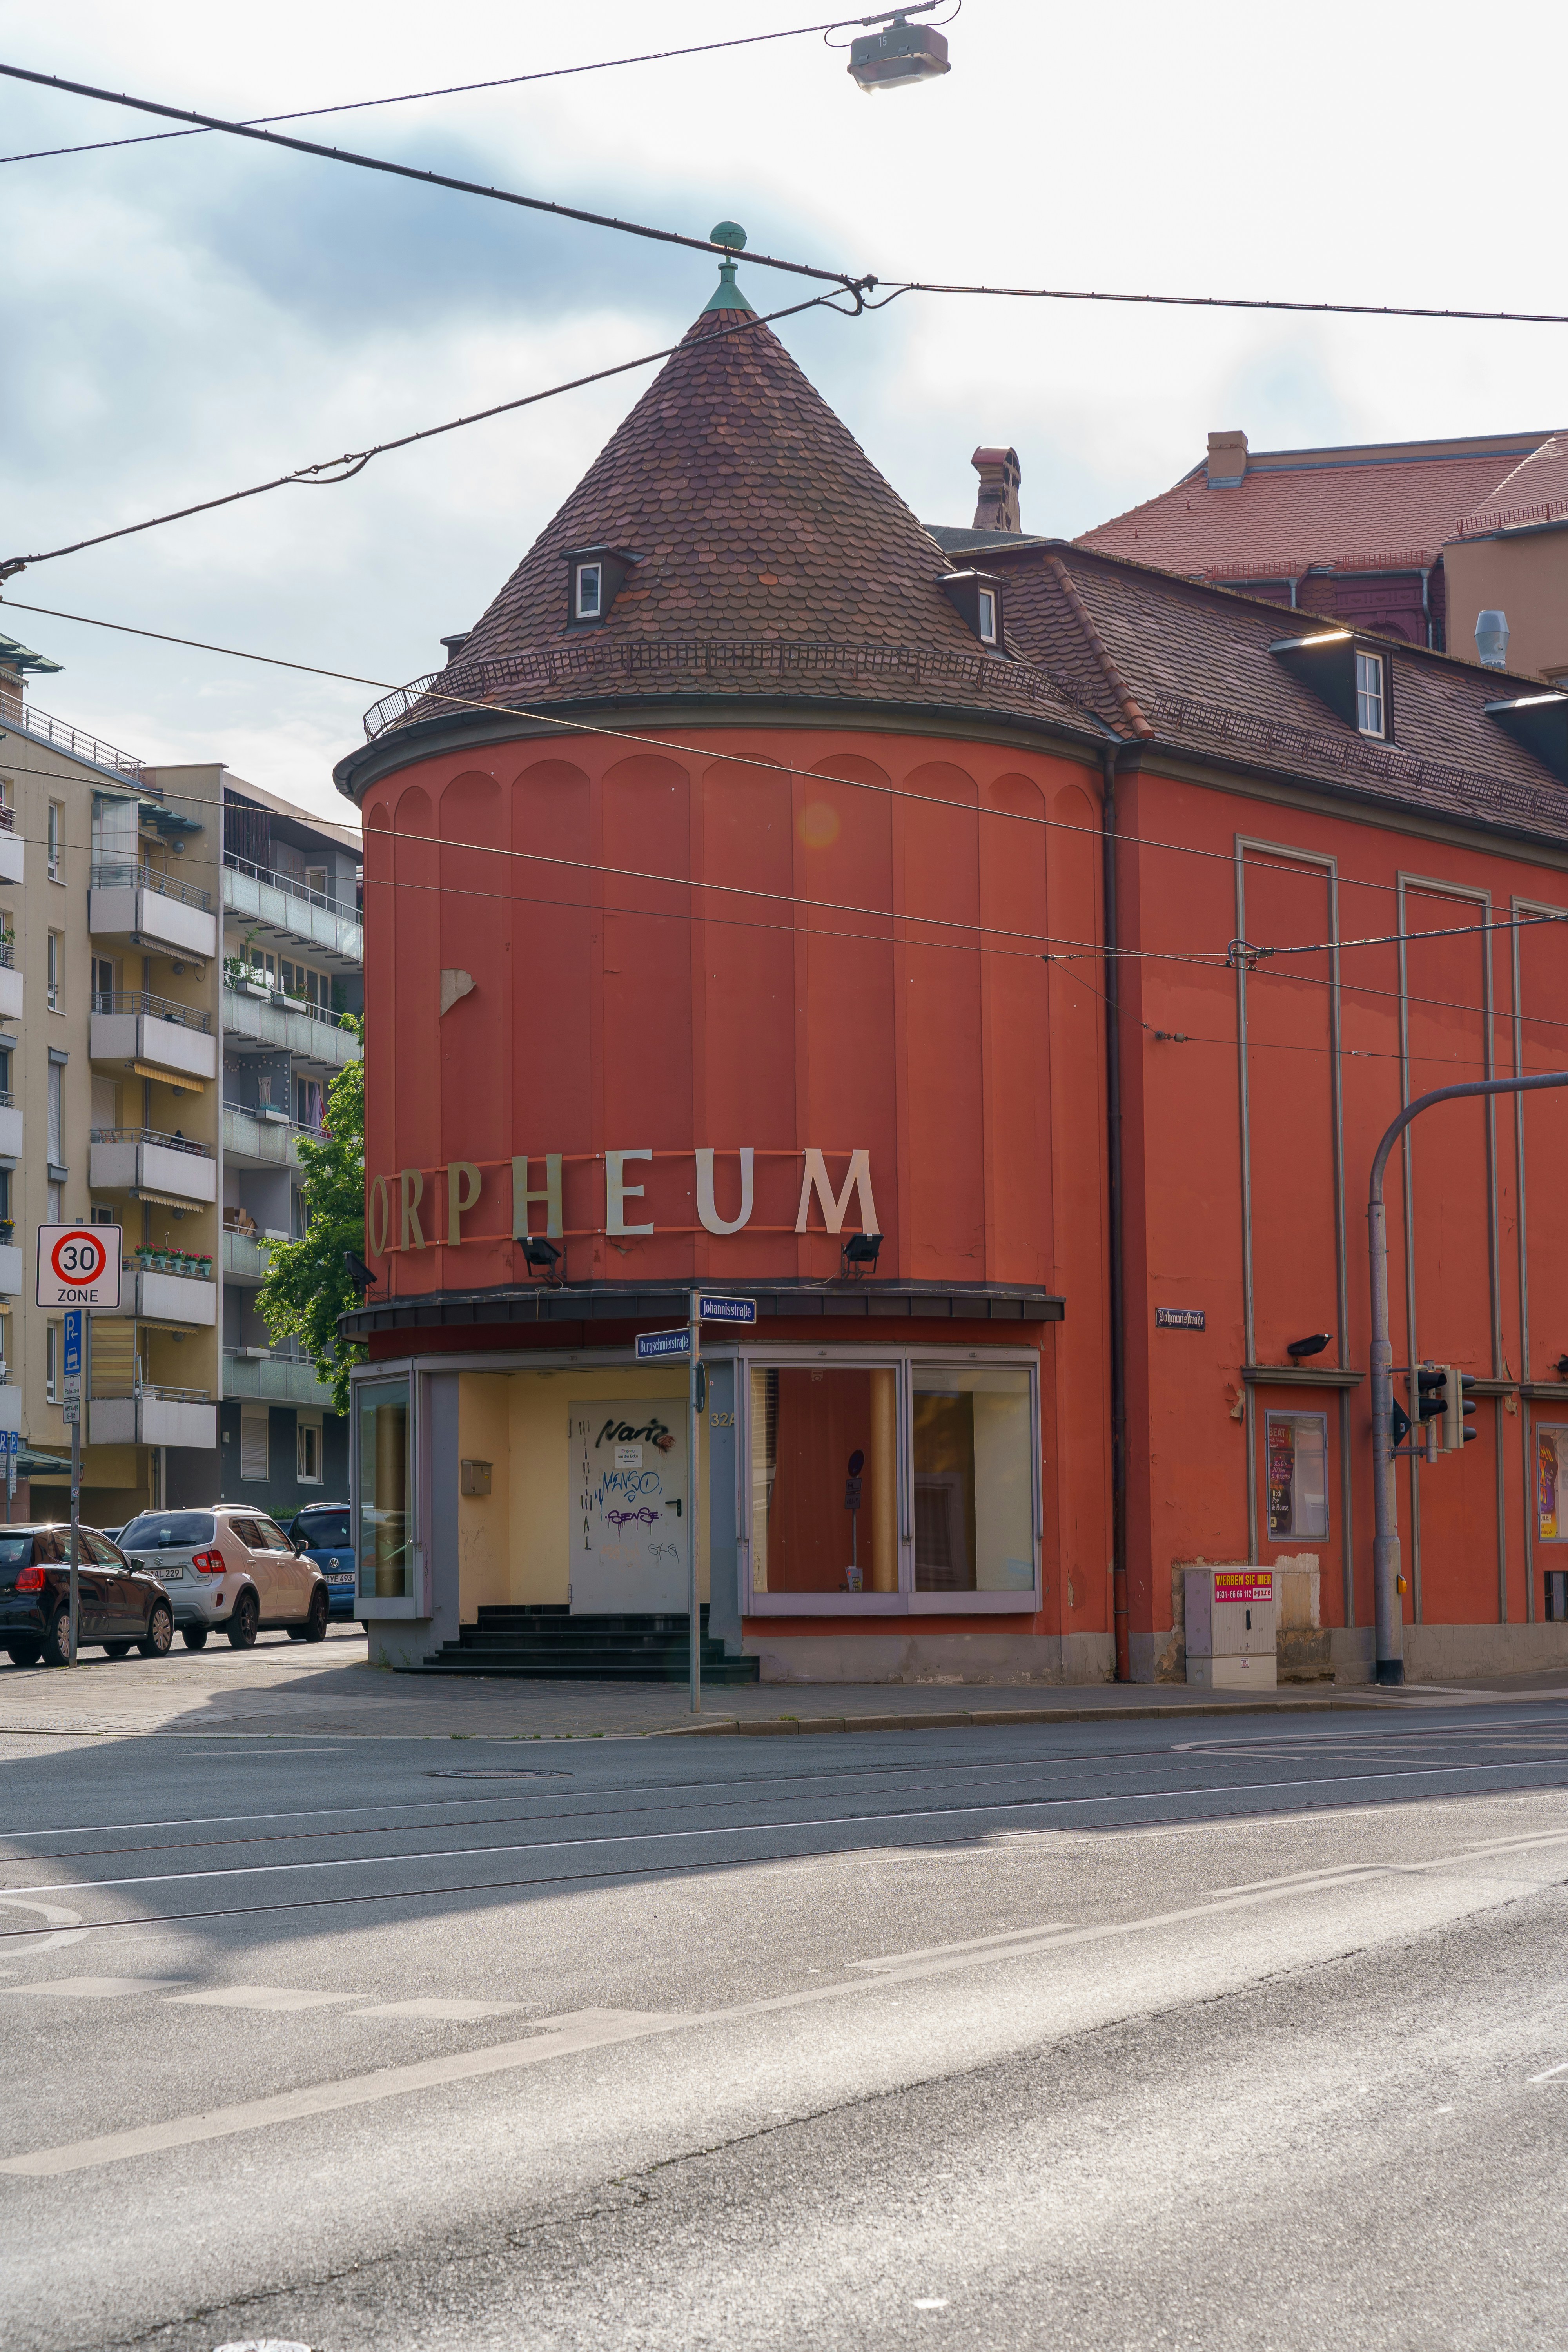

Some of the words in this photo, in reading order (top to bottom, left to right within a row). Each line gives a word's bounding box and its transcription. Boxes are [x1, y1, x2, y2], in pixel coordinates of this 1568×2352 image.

[878, 36, 887, 47] 15
[369, 1148, 880, 1257] ORPHEUM
[63, 1246, 94, 1270] 30
[58, 1289, 98, 1302] ZONE
[703, 1301, 751, 1319] Johannisstraße
[67, 1316, 74, 1340] P
[640, 1335, 688, 1354] Burgschmietstraße
[1269, 1428, 1285, 1437] BEAT
[165, 1569, 179, 1577] 229
[1216, 1575, 1243, 1586] WERBEN
[1245, 1575, 1255, 1585] SIE
[1257, 1574, 1271, 1585] HIER
[1237, 1590, 1243, 1598] 66
[1254, 1589, 1270, 1597] x-po.de
